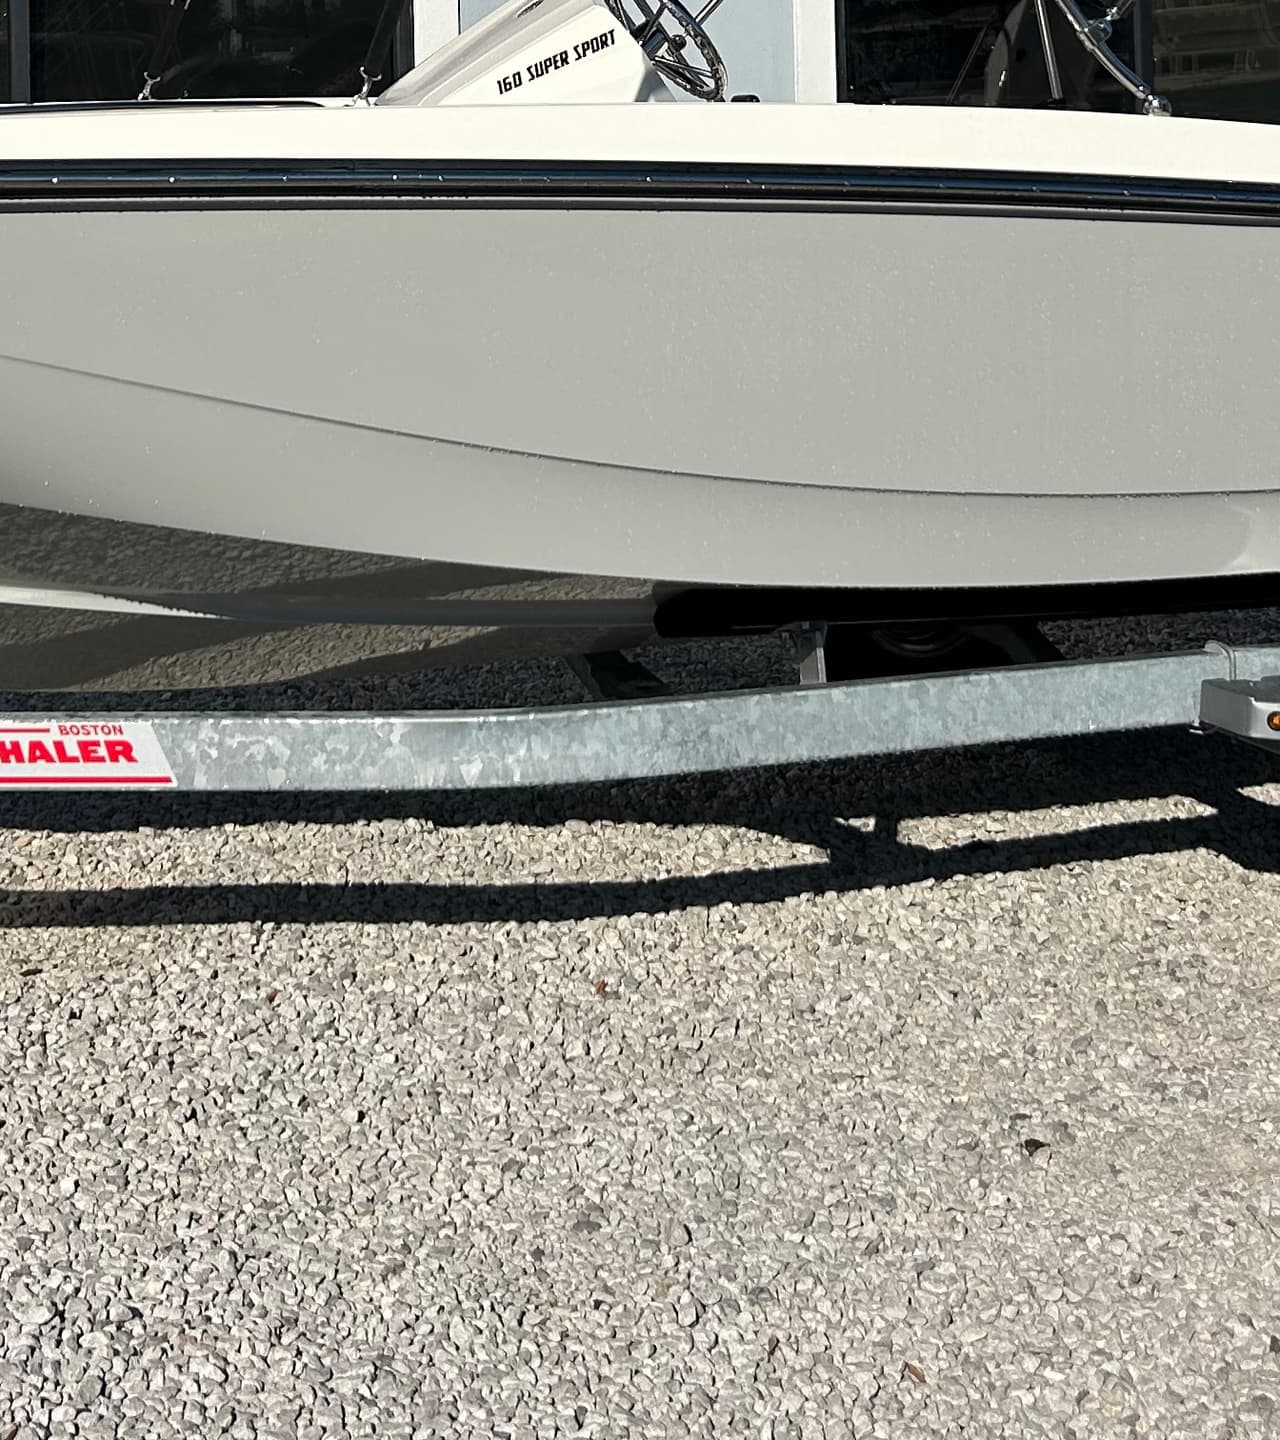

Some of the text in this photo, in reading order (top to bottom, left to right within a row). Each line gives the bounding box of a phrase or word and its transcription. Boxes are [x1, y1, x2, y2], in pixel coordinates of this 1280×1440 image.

[496, 28, 616, 95] 160 SUPER SPORT
[58, 724, 124, 736] BOSTON
